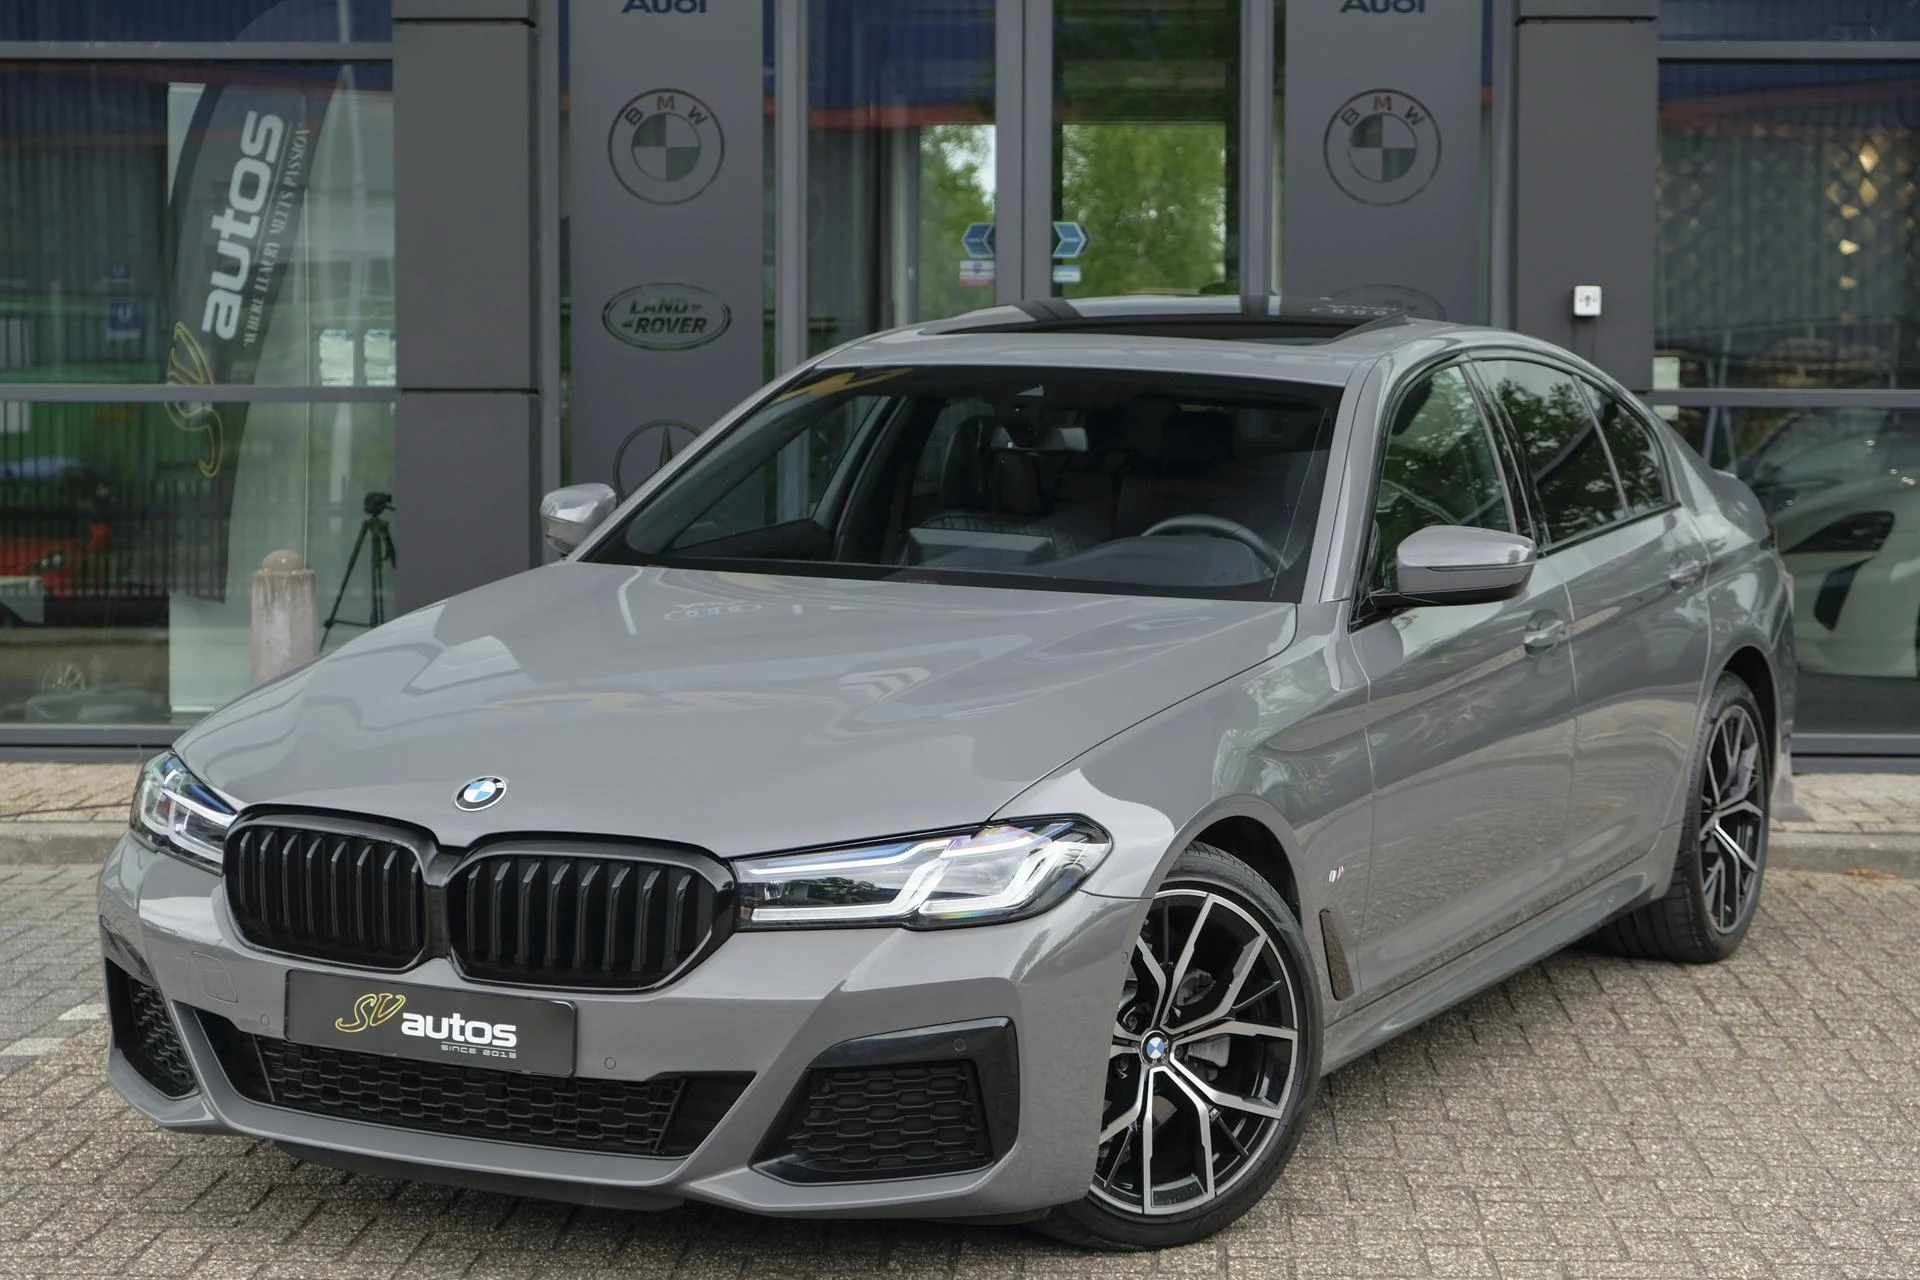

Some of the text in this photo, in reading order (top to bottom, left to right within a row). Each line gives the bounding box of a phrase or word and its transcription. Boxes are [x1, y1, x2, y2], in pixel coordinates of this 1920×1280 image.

[624, 95, 708, 126] BMW
[1341, 95, 1425, 126] BMW
[201, 110, 284, 340] autos
[629, 299, 688, 314] LAND
[634, 317, 708, 333] ROVER
[335, 993, 517, 1048] SV autos
[441, 1044, 477, 1055] SINCE
